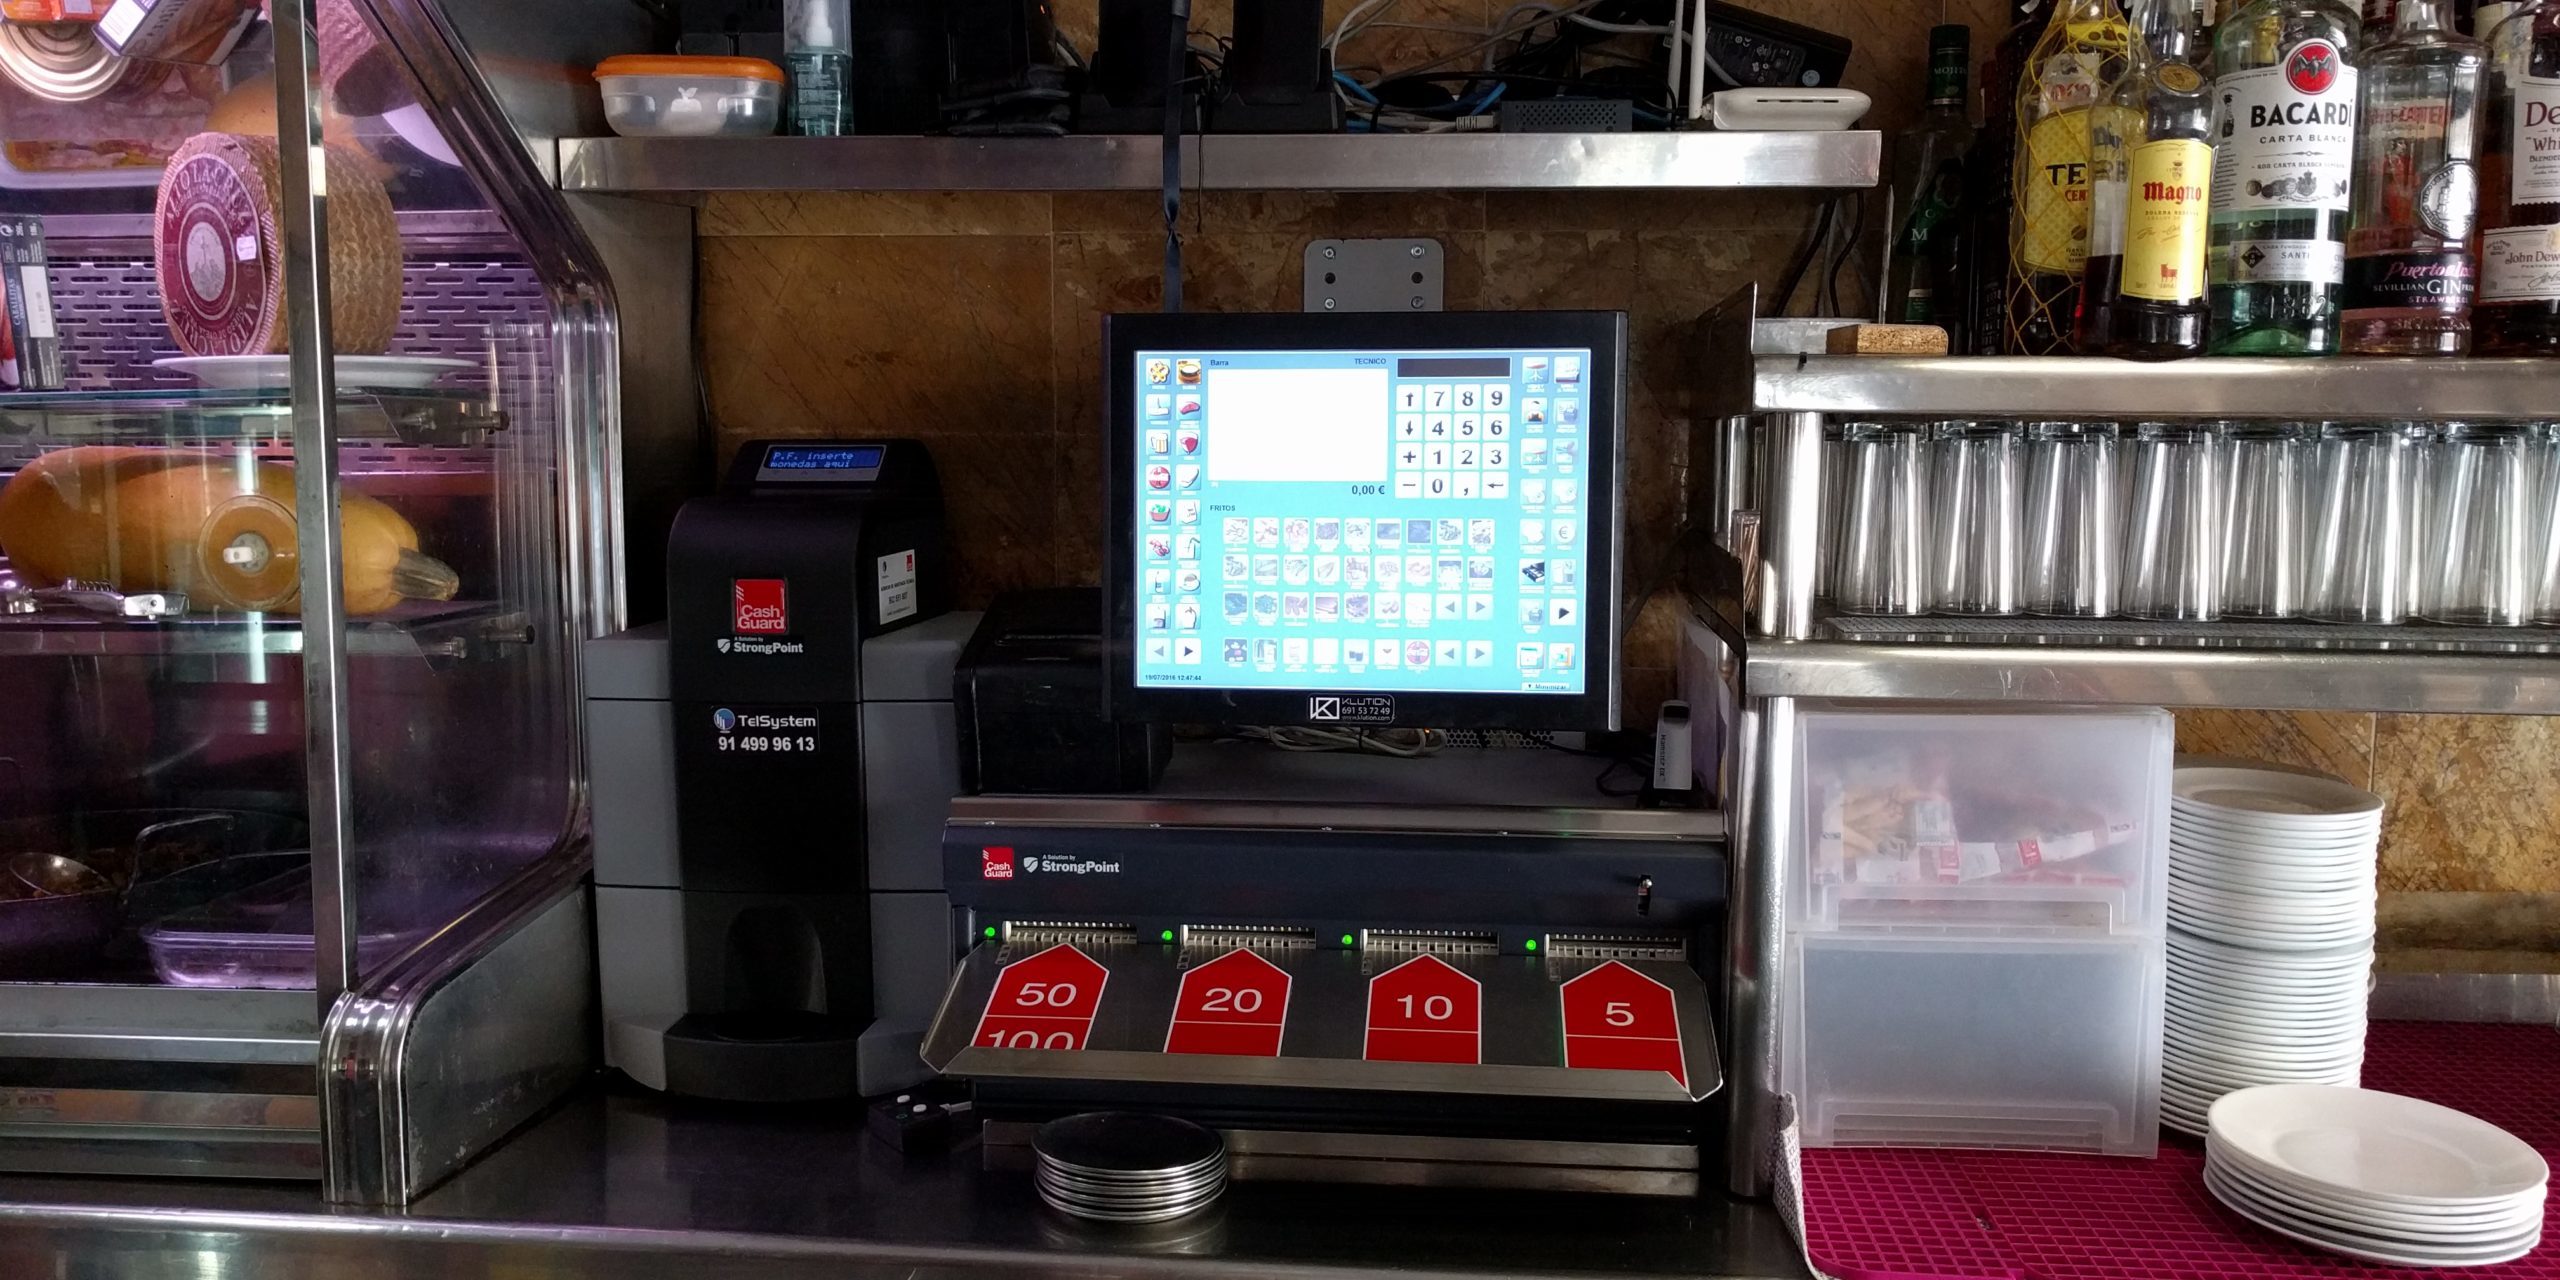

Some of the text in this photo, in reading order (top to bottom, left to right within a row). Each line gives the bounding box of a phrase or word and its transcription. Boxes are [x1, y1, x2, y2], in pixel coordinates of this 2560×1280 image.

[2259, 134, 2346, 144] CARTA BLANCA
[2143, 181, 2201, 205] Magno
[2281, 252, 2310, 260] SANTI
[2535, 250, 2560, 262] Dew
[2426, 279, 2461, 294] GIN
[1210, 358, 1229, 367] Barra
[1354, 357, 1387, 365] TECNICO
[1433, 390, 1503, 406] 7 8 9
[1432, 420, 1503, 436] 4 5 6
[807, 451, 854, 460] inserte
[1433, 450, 1442, 465] 1
[1461, 449, 1473, 465] 2
[1490, 449, 1502, 464] 3
[770, 459, 817, 468] monedas
[1351, 485, 1385, 497] 0,00 €
[1432, 478, 1443, 494] 0
[1210, 504, 1236, 512] FRITOS
[741, 604, 780, 618] Cash
[738, 616, 786, 629] Guard
[734, 641, 804, 655] StrongPoint
[1341, 697, 1391, 706] KLUTION
[1341, 706, 1391, 715] 691 53 72 49
[738, 715, 816, 730] TelSystem
[718, 736, 815, 751] 91 499 96 13
[986, 861, 1010, 870] Cash
[1042, 860, 1120, 875] StrongPoint
[984, 868, 1013, 878] Guard
[1016, 982, 1077, 1007] 50
[1201, 987, 1263, 1013] 20
[1397, 995, 1453, 1020] 10
[1605, 1001, 1635, 1027] 5
[987, 1029, 1075, 1050] 100
